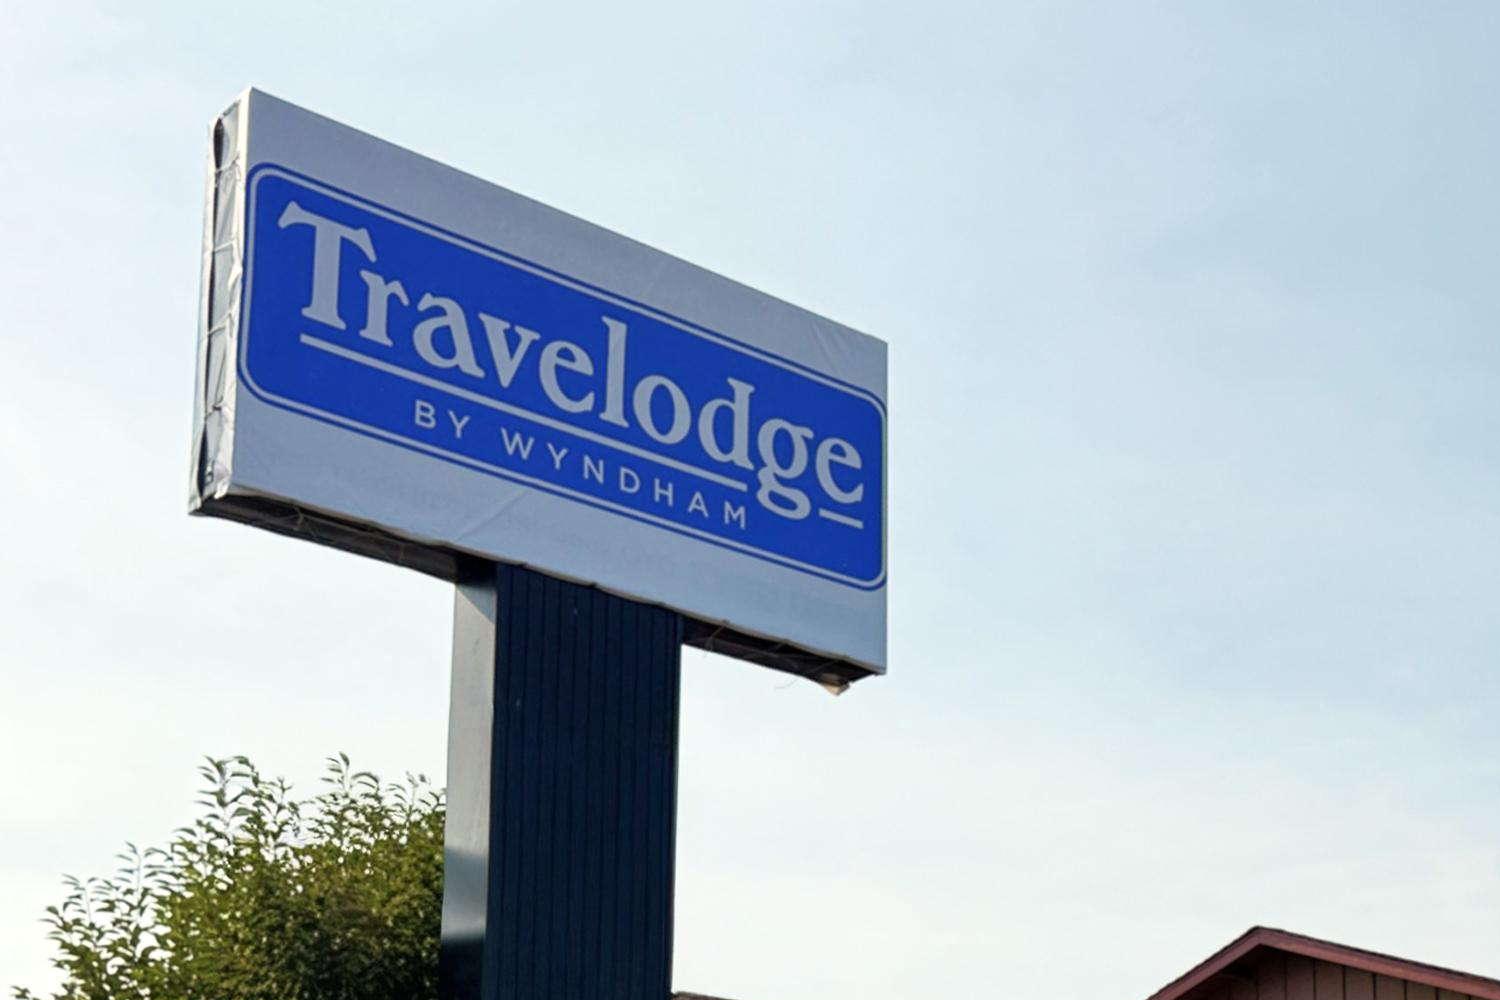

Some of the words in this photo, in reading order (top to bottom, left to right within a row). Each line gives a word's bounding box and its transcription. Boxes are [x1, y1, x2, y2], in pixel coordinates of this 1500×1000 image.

[278, 201, 864, 520] Travelodge
[414, 399, 470, 438] BY
[501, 428, 746, 530] WYNDHAM
